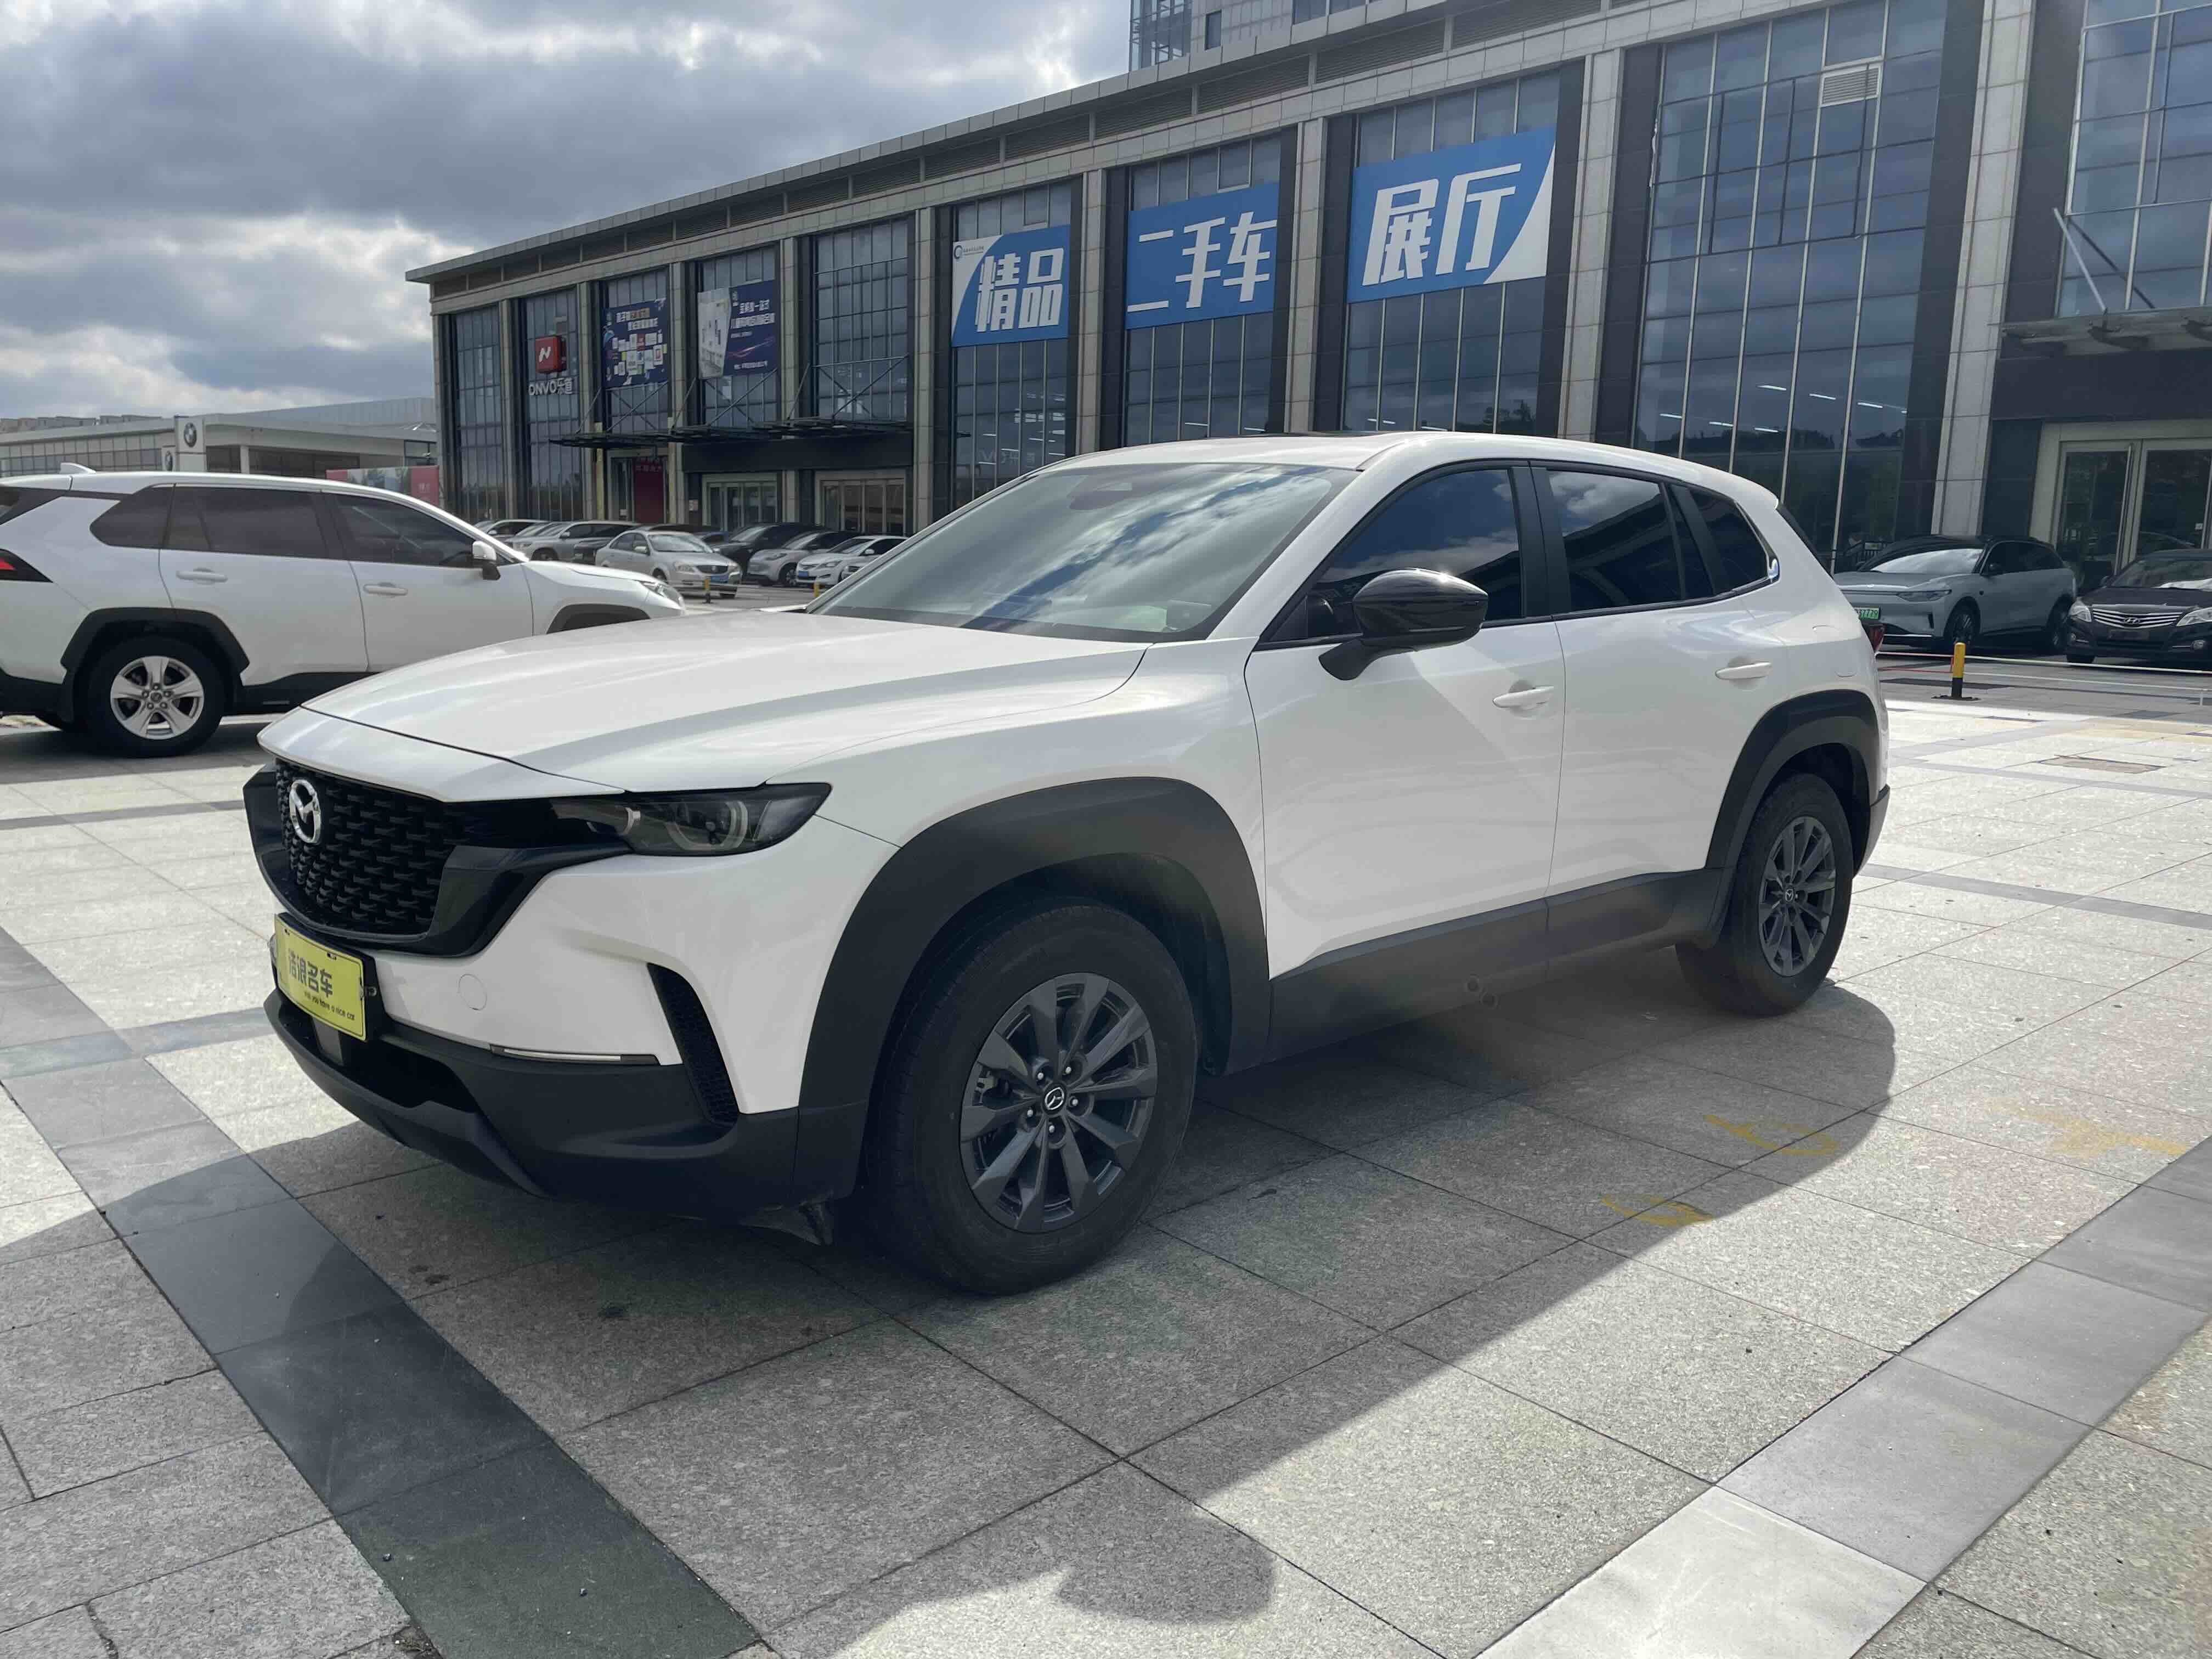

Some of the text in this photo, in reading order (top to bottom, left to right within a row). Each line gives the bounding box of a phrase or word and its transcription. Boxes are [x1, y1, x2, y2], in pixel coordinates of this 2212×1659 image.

[975, 163, 1522, 332] 精品 二手车 展厅
